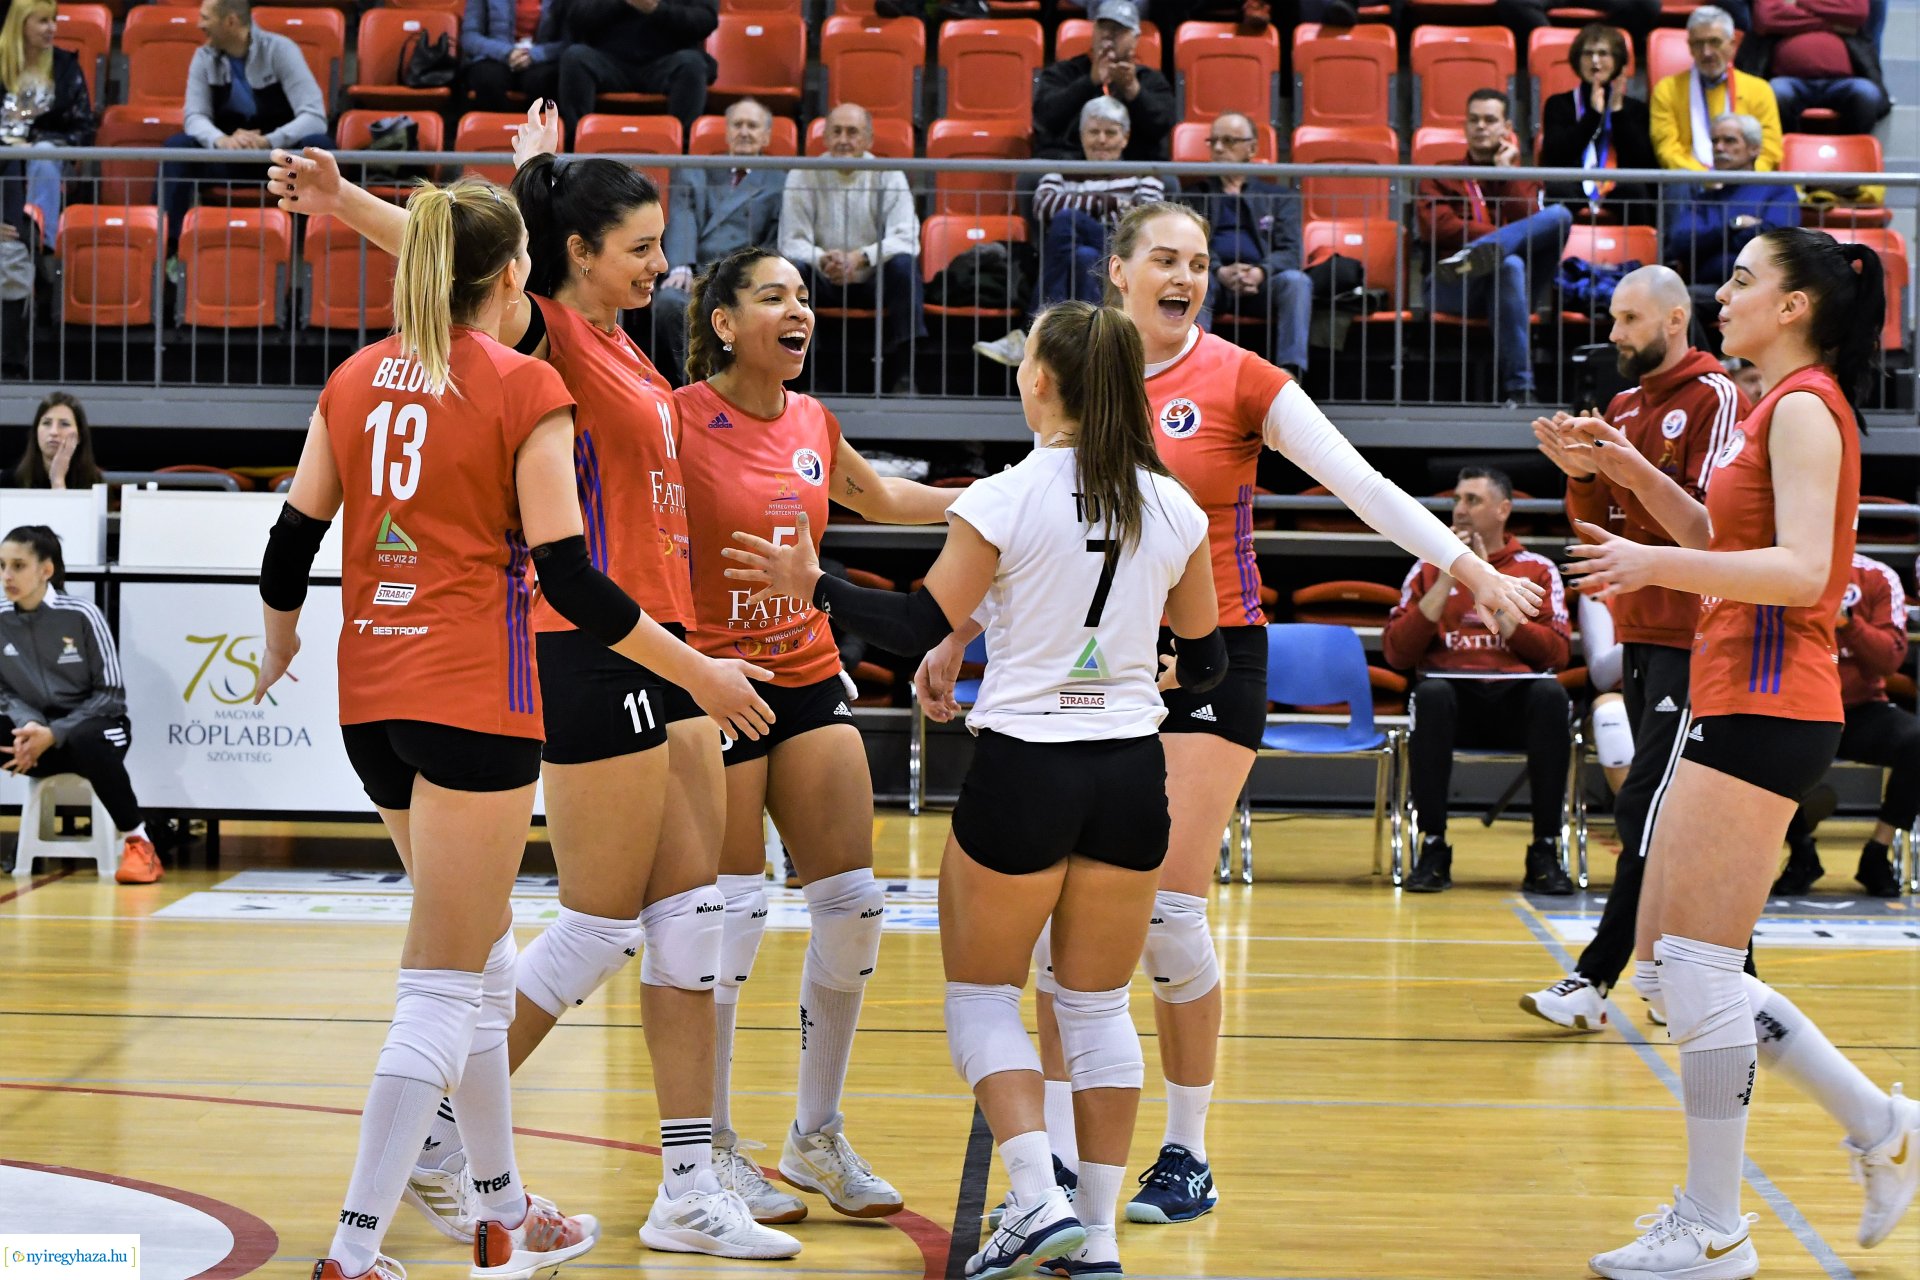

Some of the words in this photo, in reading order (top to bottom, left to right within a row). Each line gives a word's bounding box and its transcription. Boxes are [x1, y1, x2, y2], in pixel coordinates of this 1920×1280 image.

[372, 357, 451, 396] BELO
[656, 400, 677, 460] 11
[364, 401, 428, 501] 13
[649, 468, 686, 509] FATU
[378, 554, 407, 564] KE-VIZ
[408, 556, 418, 564] 21
[377, 589, 412, 600] STRABAG
[1083, 539, 1120, 628] 7
[372, 626, 429, 636] BESTRONG
[623, 689, 656, 734] 11
[1060, 696, 1105, 706] STRABAG
[214, 710, 265, 720] MAGYAR
[1190, 711, 1217, 722] adidas
[168, 719, 312, 747] RÖPLABDA
[207, 750, 272, 763] SZÖVETSÉG
[471, 1171, 511, 1193] rrea
